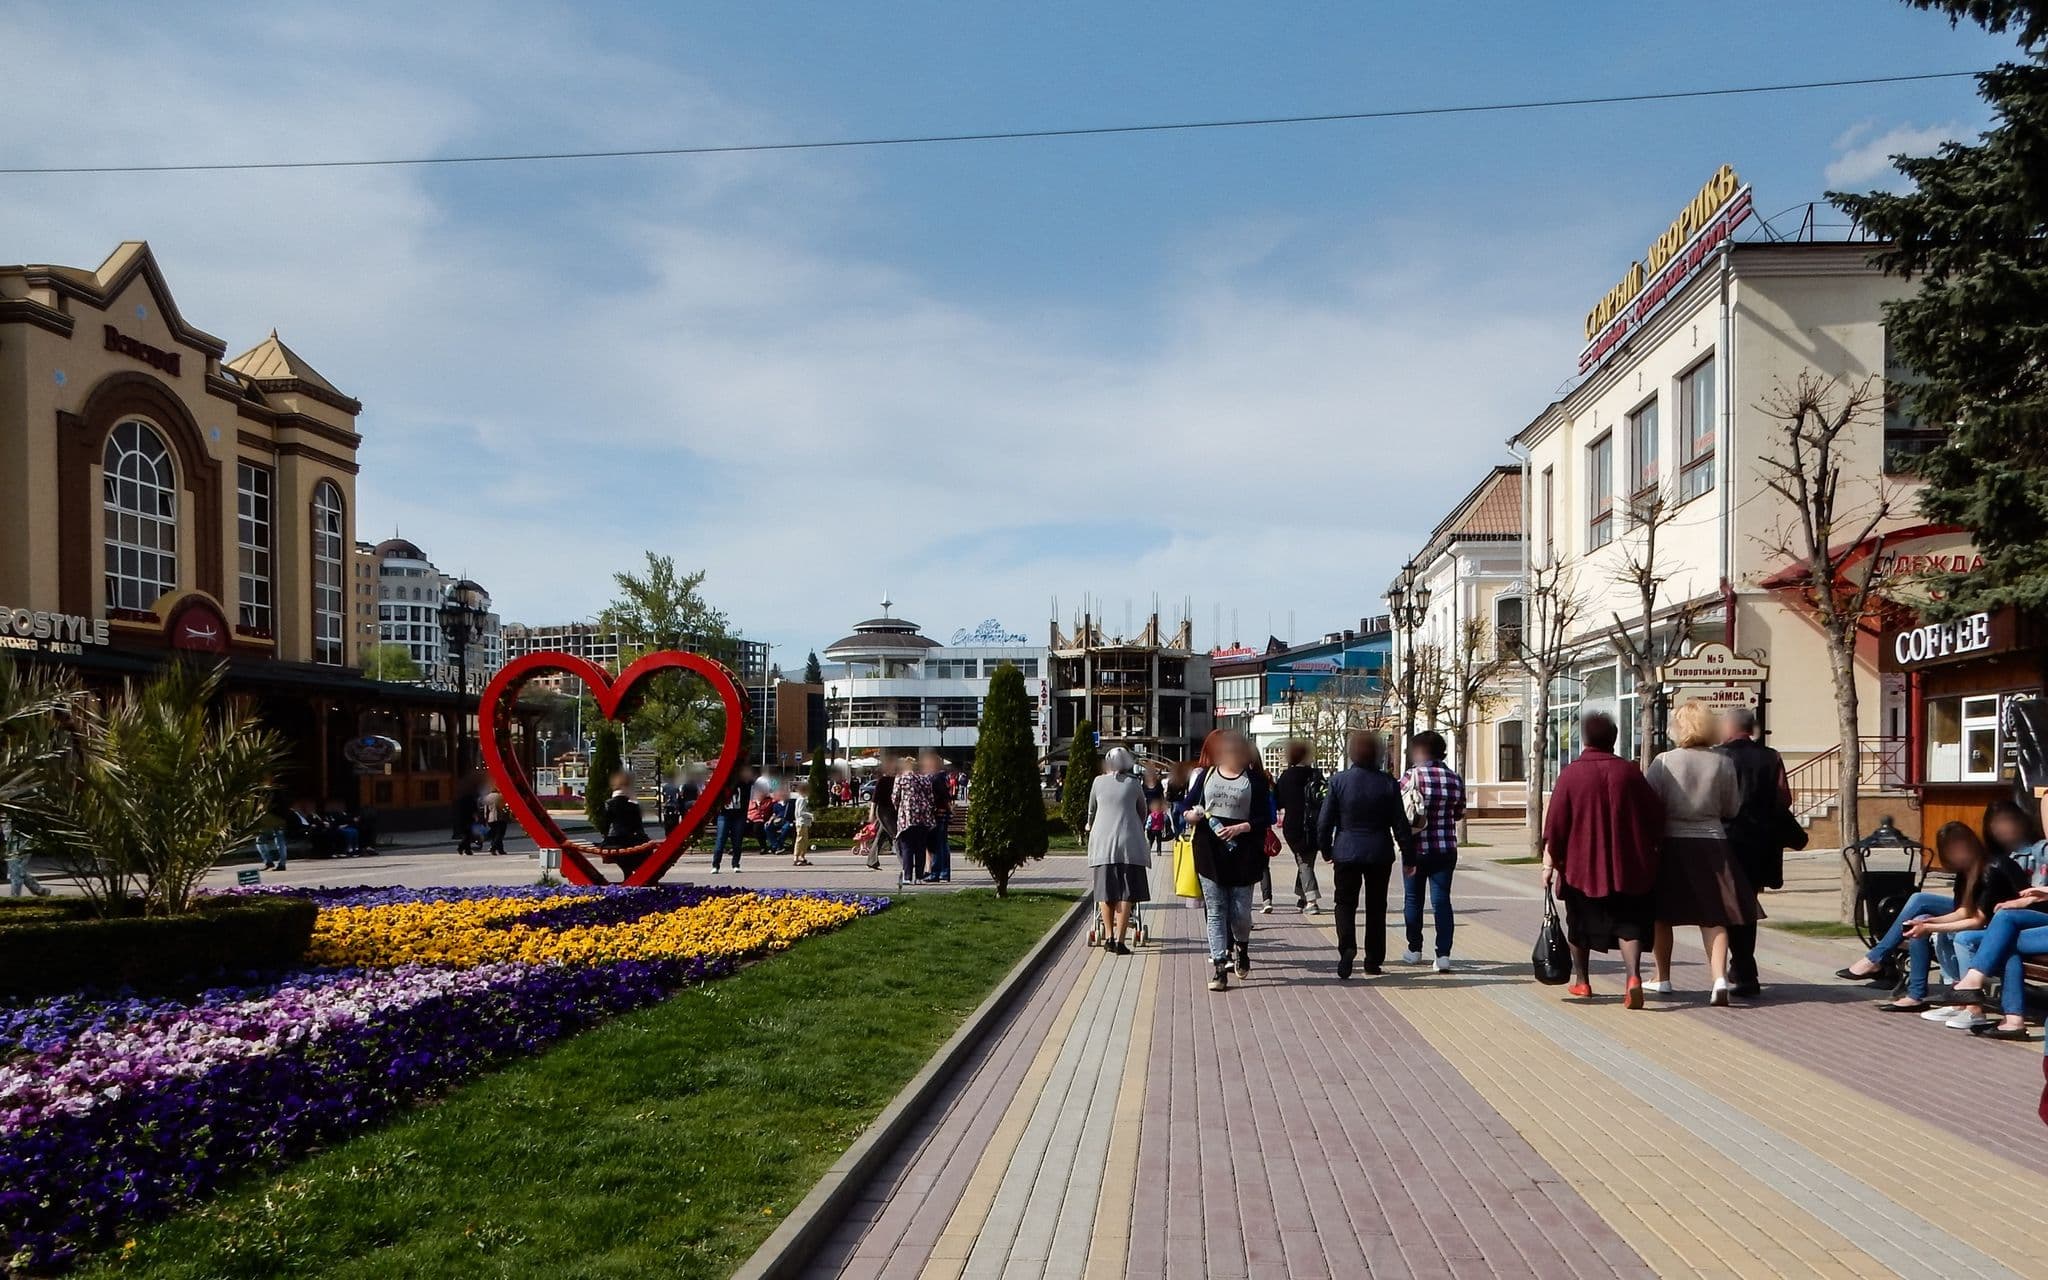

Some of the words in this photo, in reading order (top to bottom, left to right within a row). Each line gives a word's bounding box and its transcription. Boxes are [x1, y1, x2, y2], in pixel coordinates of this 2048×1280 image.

[1585, 261, 1643, 340] СТАРЫЙ
[1895, 612, 1990, 664] COFFEE
[1718, 655, 1724, 663] 5
[1674, 667, 1720, 676] Курортный
[1722, 668, 1757, 676] бульвар
[1713, 690, 1744, 701] ЭЙМСА
[1274, 706, 1317, 720] АПЕКА
